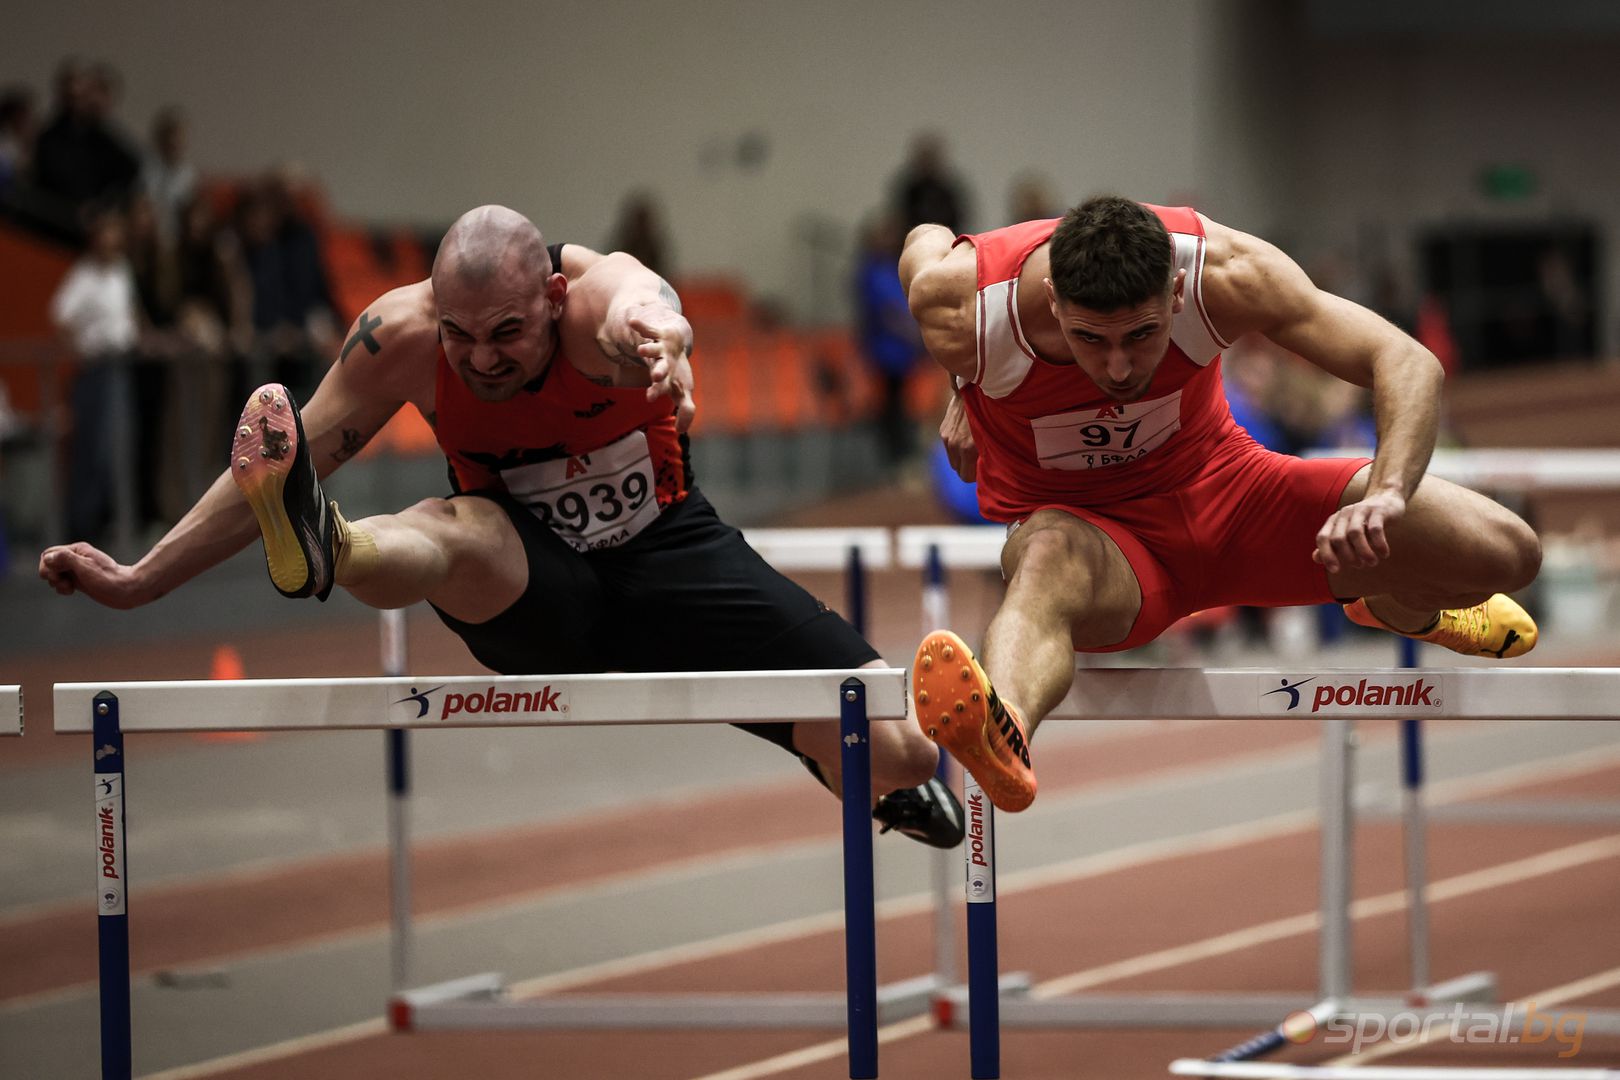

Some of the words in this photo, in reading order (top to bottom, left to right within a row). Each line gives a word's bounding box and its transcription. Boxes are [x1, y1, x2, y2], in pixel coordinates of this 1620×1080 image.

[1079, 420, 1142, 449] 97
[565, 455, 592, 480] A1
[1101, 448, 1147, 466] БФЛА
[441, 685, 562, 721] polanik
[1311, 678, 1435, 713] polanik
[99, 806, 119, 880] polanik
[968, 793, 988, 867] polanik
